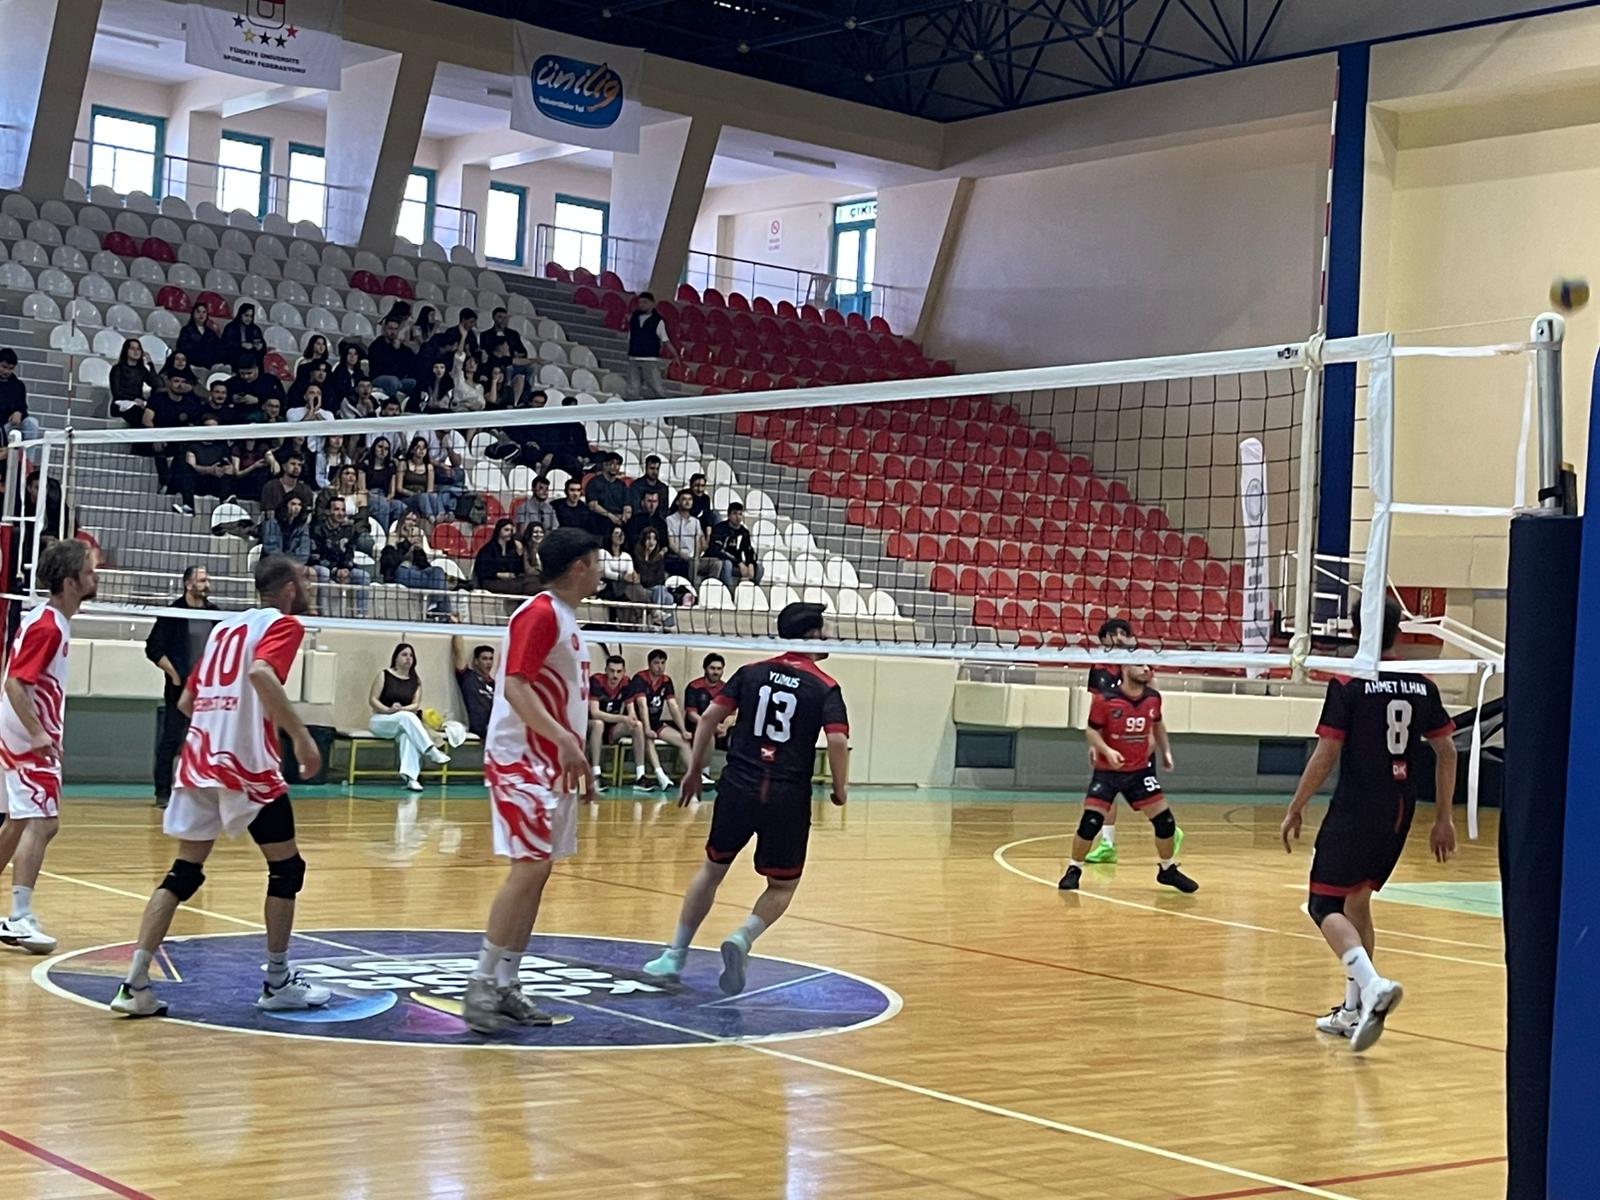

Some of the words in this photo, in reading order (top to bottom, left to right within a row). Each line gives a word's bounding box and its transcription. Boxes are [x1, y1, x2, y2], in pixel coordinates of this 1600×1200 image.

[204, 623, 248, 687] 10
[769, 670, 800, 689] YUNUS
[1364, 681, 1398, 694] AHMET
[753, 685, 797, 743] 13
[1125, 717, 1146, 732] 99
[1386, 699, 1413, 755] 8
